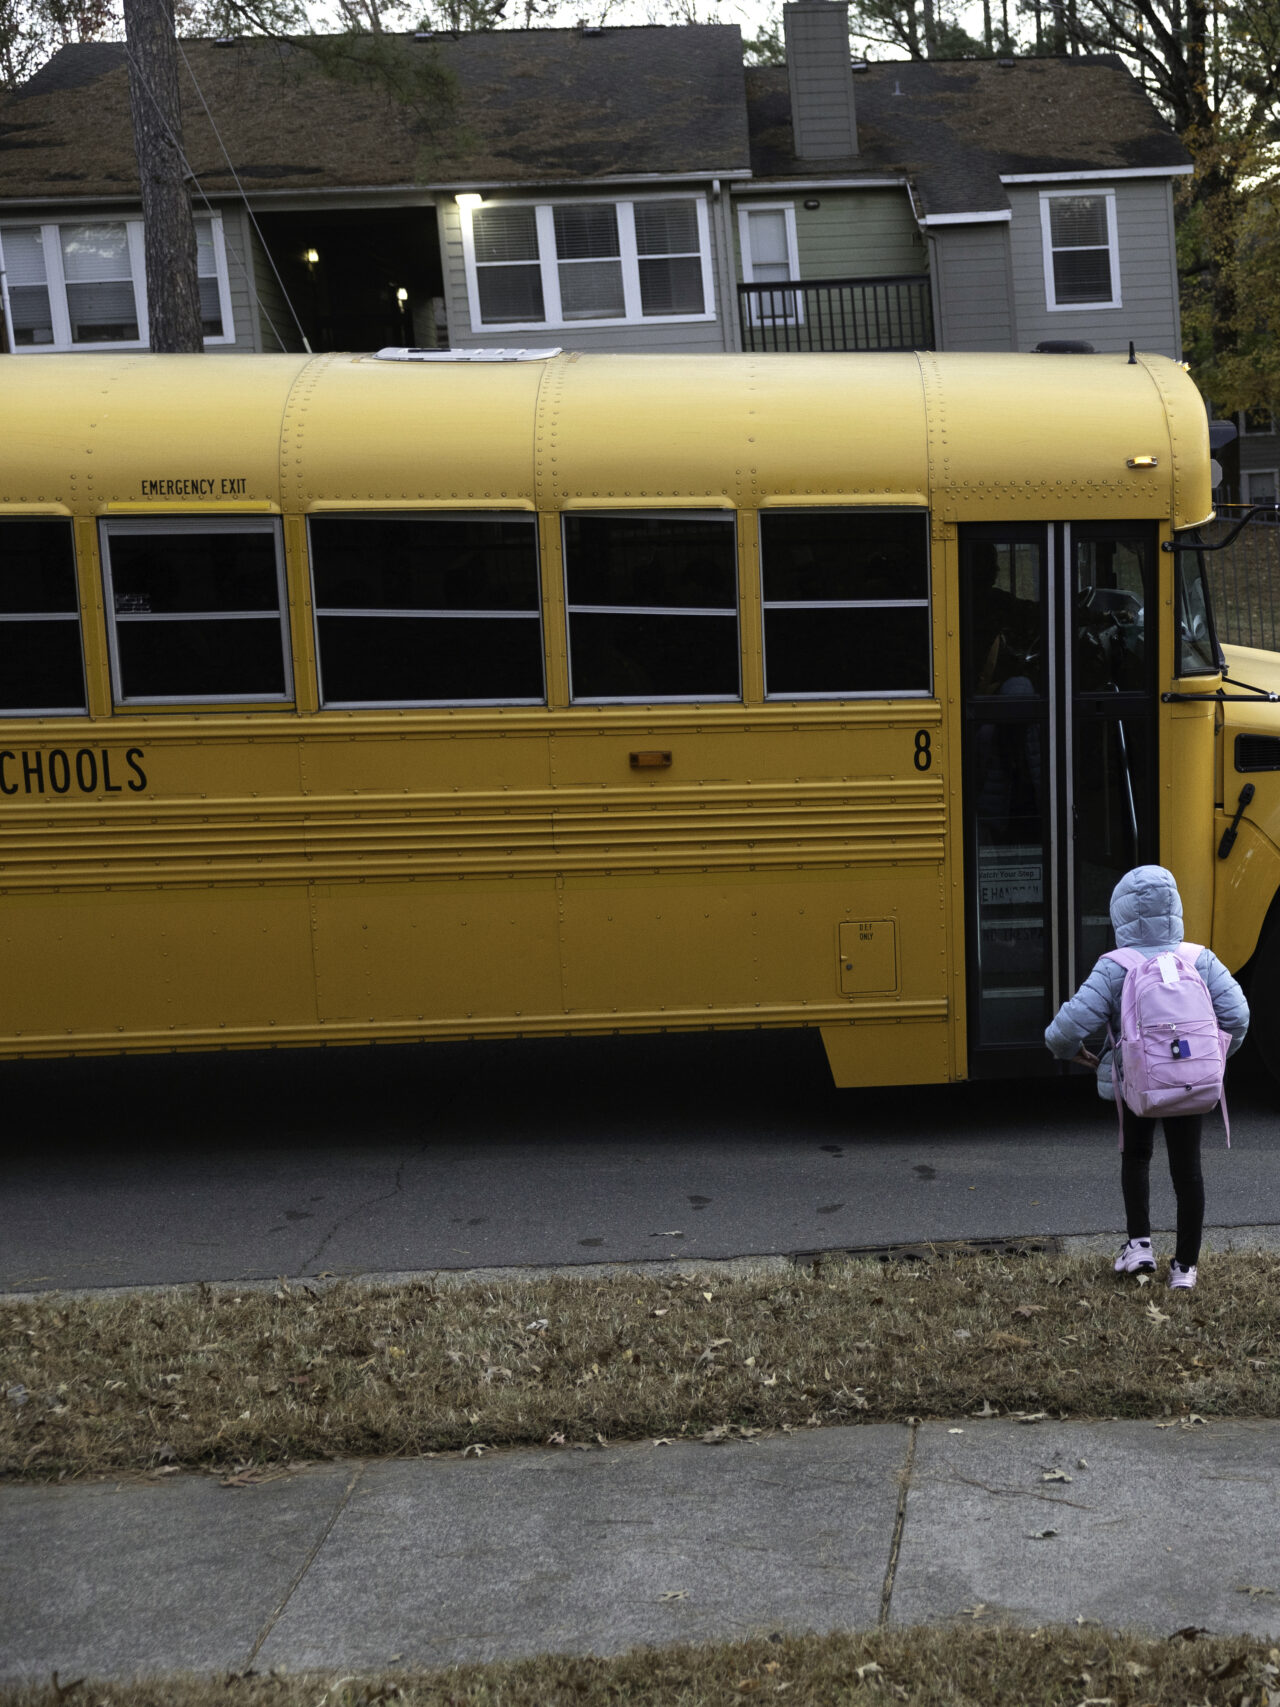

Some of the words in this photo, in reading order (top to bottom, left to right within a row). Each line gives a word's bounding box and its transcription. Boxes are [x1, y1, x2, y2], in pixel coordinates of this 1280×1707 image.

[141, 479, 215, 495] EMERGENCY
[221, 478, 247, 494] EXIT
[914, 729, 932, 771] 8
[0, 748, 147, 795] CHOOLS
[1000, 870, 1017, 878] Your
[1018, 870, 1034, 879] Step
[859, 932, 874, 941] ONLY
